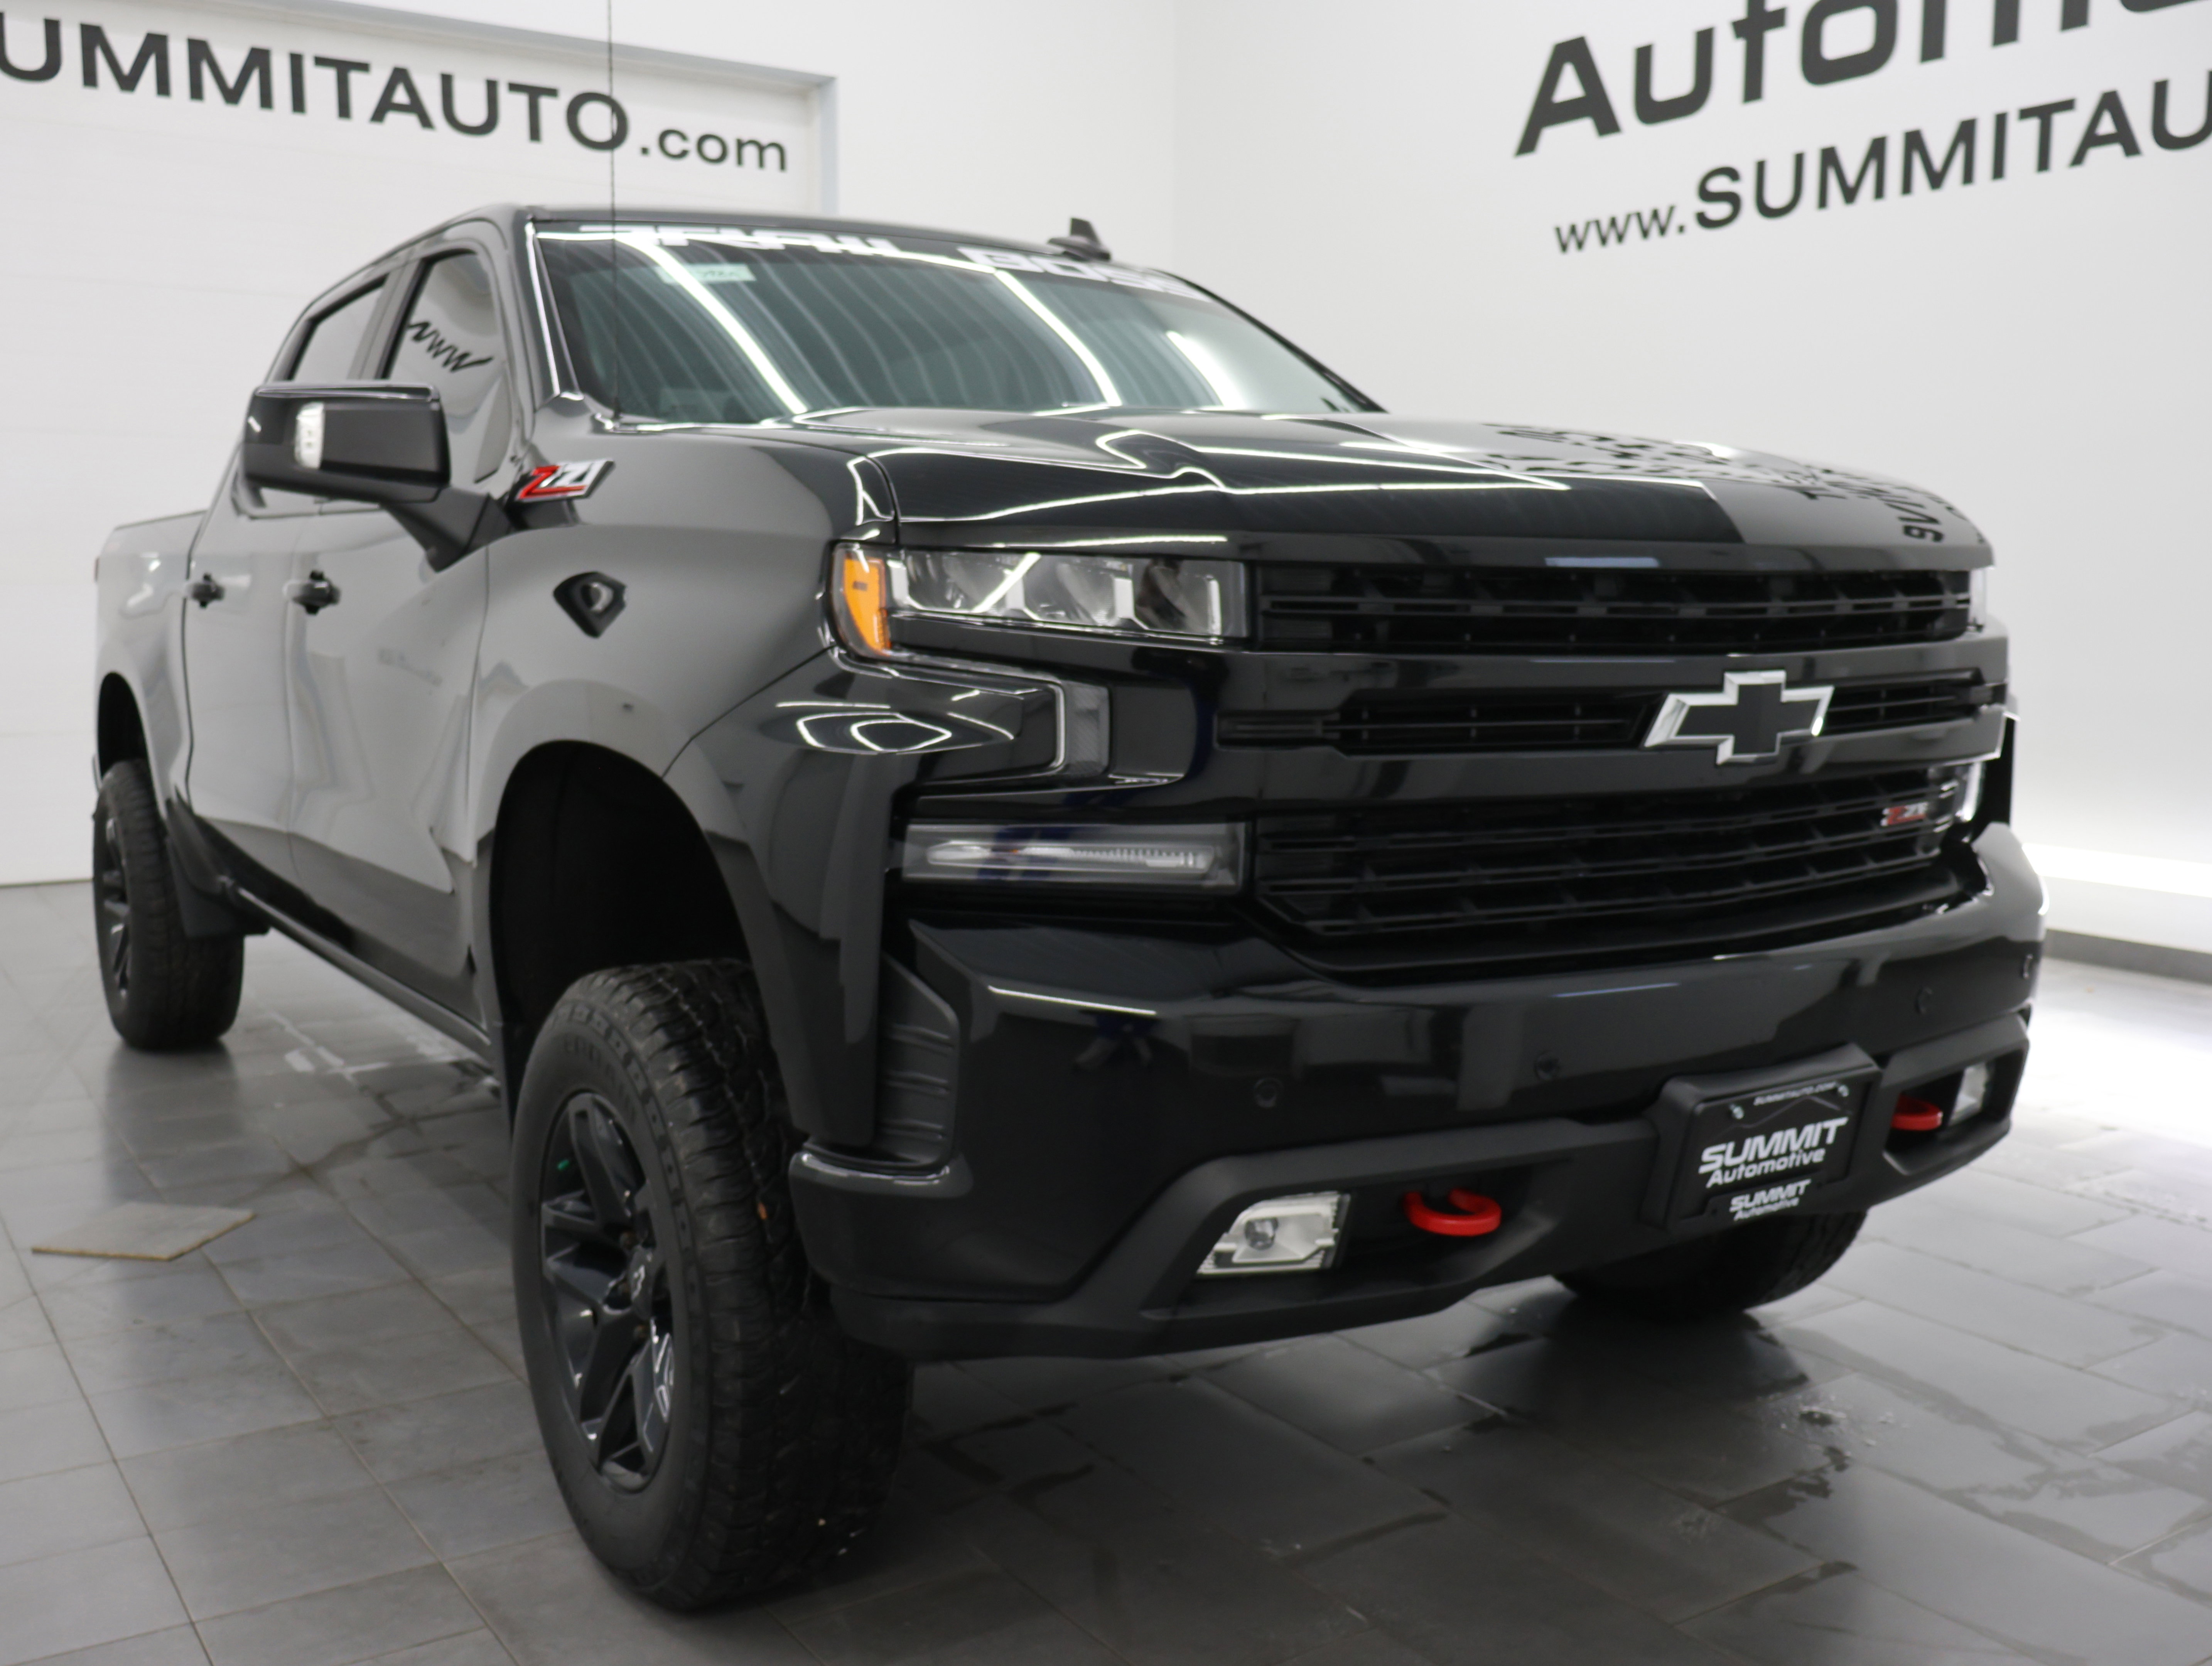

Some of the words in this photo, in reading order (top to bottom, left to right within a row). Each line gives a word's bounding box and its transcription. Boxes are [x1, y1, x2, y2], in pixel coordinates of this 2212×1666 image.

[0, 12, 787, 172] UMMITAUTO.com
[1555, 69, 2212, 254] www.SUMMITAU
[1698, 1117, 1849, 1174] SUMMIT
[1706, 1148, 1826, 1189] Automotive
[1729, 1179, 1812, 1212] SUMMIT
